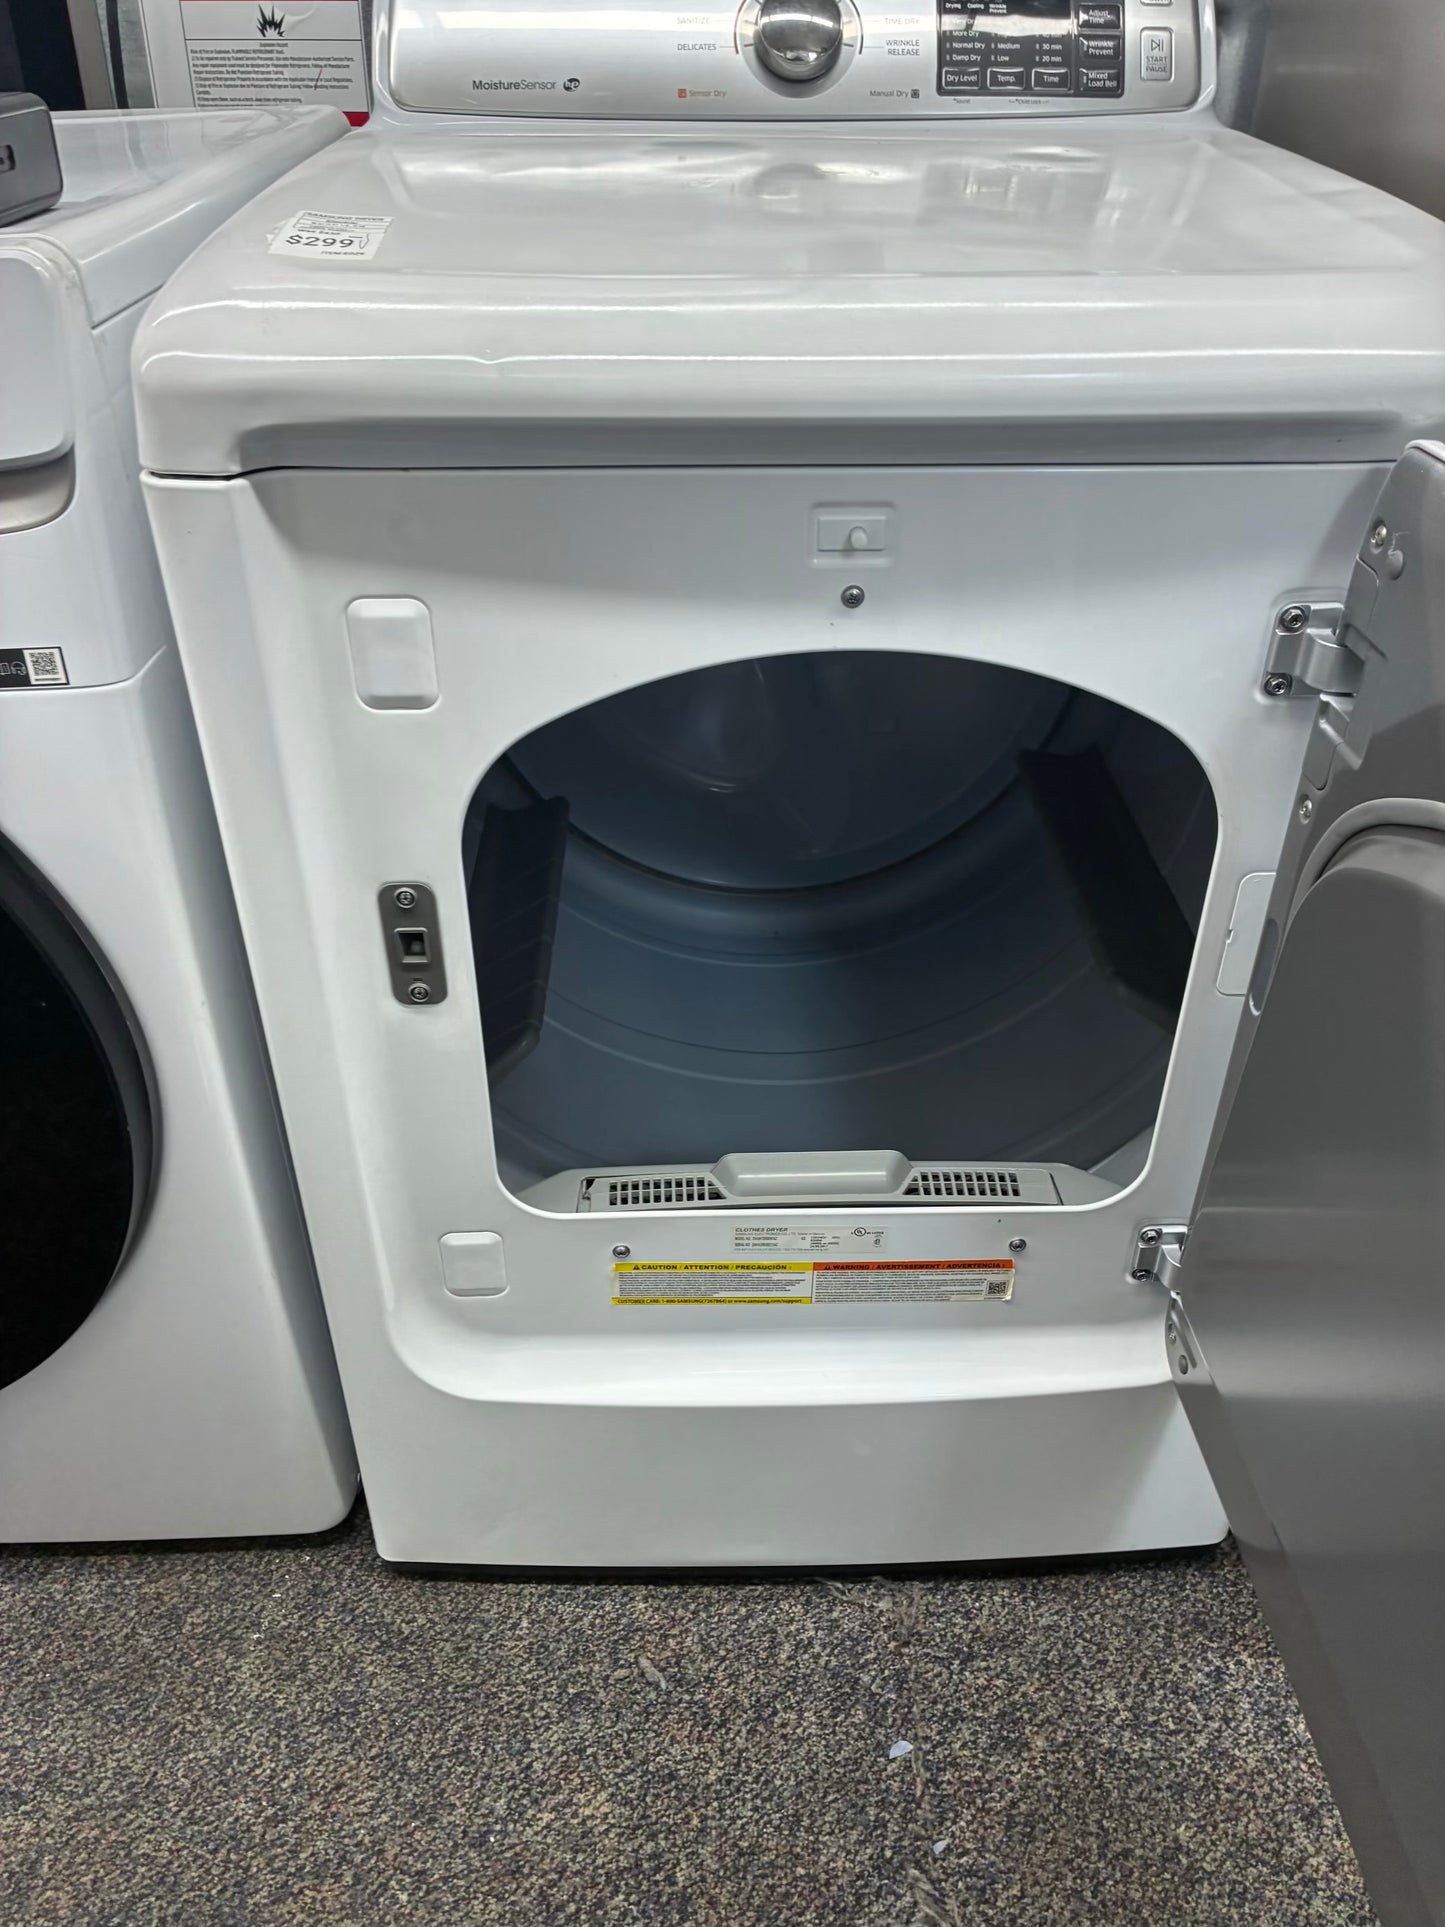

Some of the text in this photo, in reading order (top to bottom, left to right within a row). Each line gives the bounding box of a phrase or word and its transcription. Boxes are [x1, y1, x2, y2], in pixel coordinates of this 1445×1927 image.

[1088, 9, 1109, 17] Adjust
[677, 43, 717, 51] DELICATES
[885, 39, 920, 47] WRINKLE
[974, 42, 986, 50] Dry
[997, 42, 1021, 50] Medium
[1088, 40, 1114, 48] Wrinkle
[887, 48, 920, 56] RELEASE
[1088, 48, 1114, 56] Prevent
[1042, 55, 1050, 63] 20
[1145, 65, 1168, 73] PAUSE
[946, 74, 978, 82] Dry Level
[997, 75, 1016, 83] Temp.
[1088, 71, 1108, 79] Mixed
[472, 79, 557, 91] MoistureSensor
[1104, 80, 1118, 88] Bell
[688, 89, 727, 99] Sensor Dry
[869, 89, 910, 98] Manual Dry
[285, 234, 354, 248] $299
[735, 1263, 788, 1271] PRECAUCIÓN
[832, 1263, 870, 1271] WARNING
[876, 1262, 941, 1271] AVERTISSEMENT
[946, 1262, 1001, 1270] ADVERTENCIA
